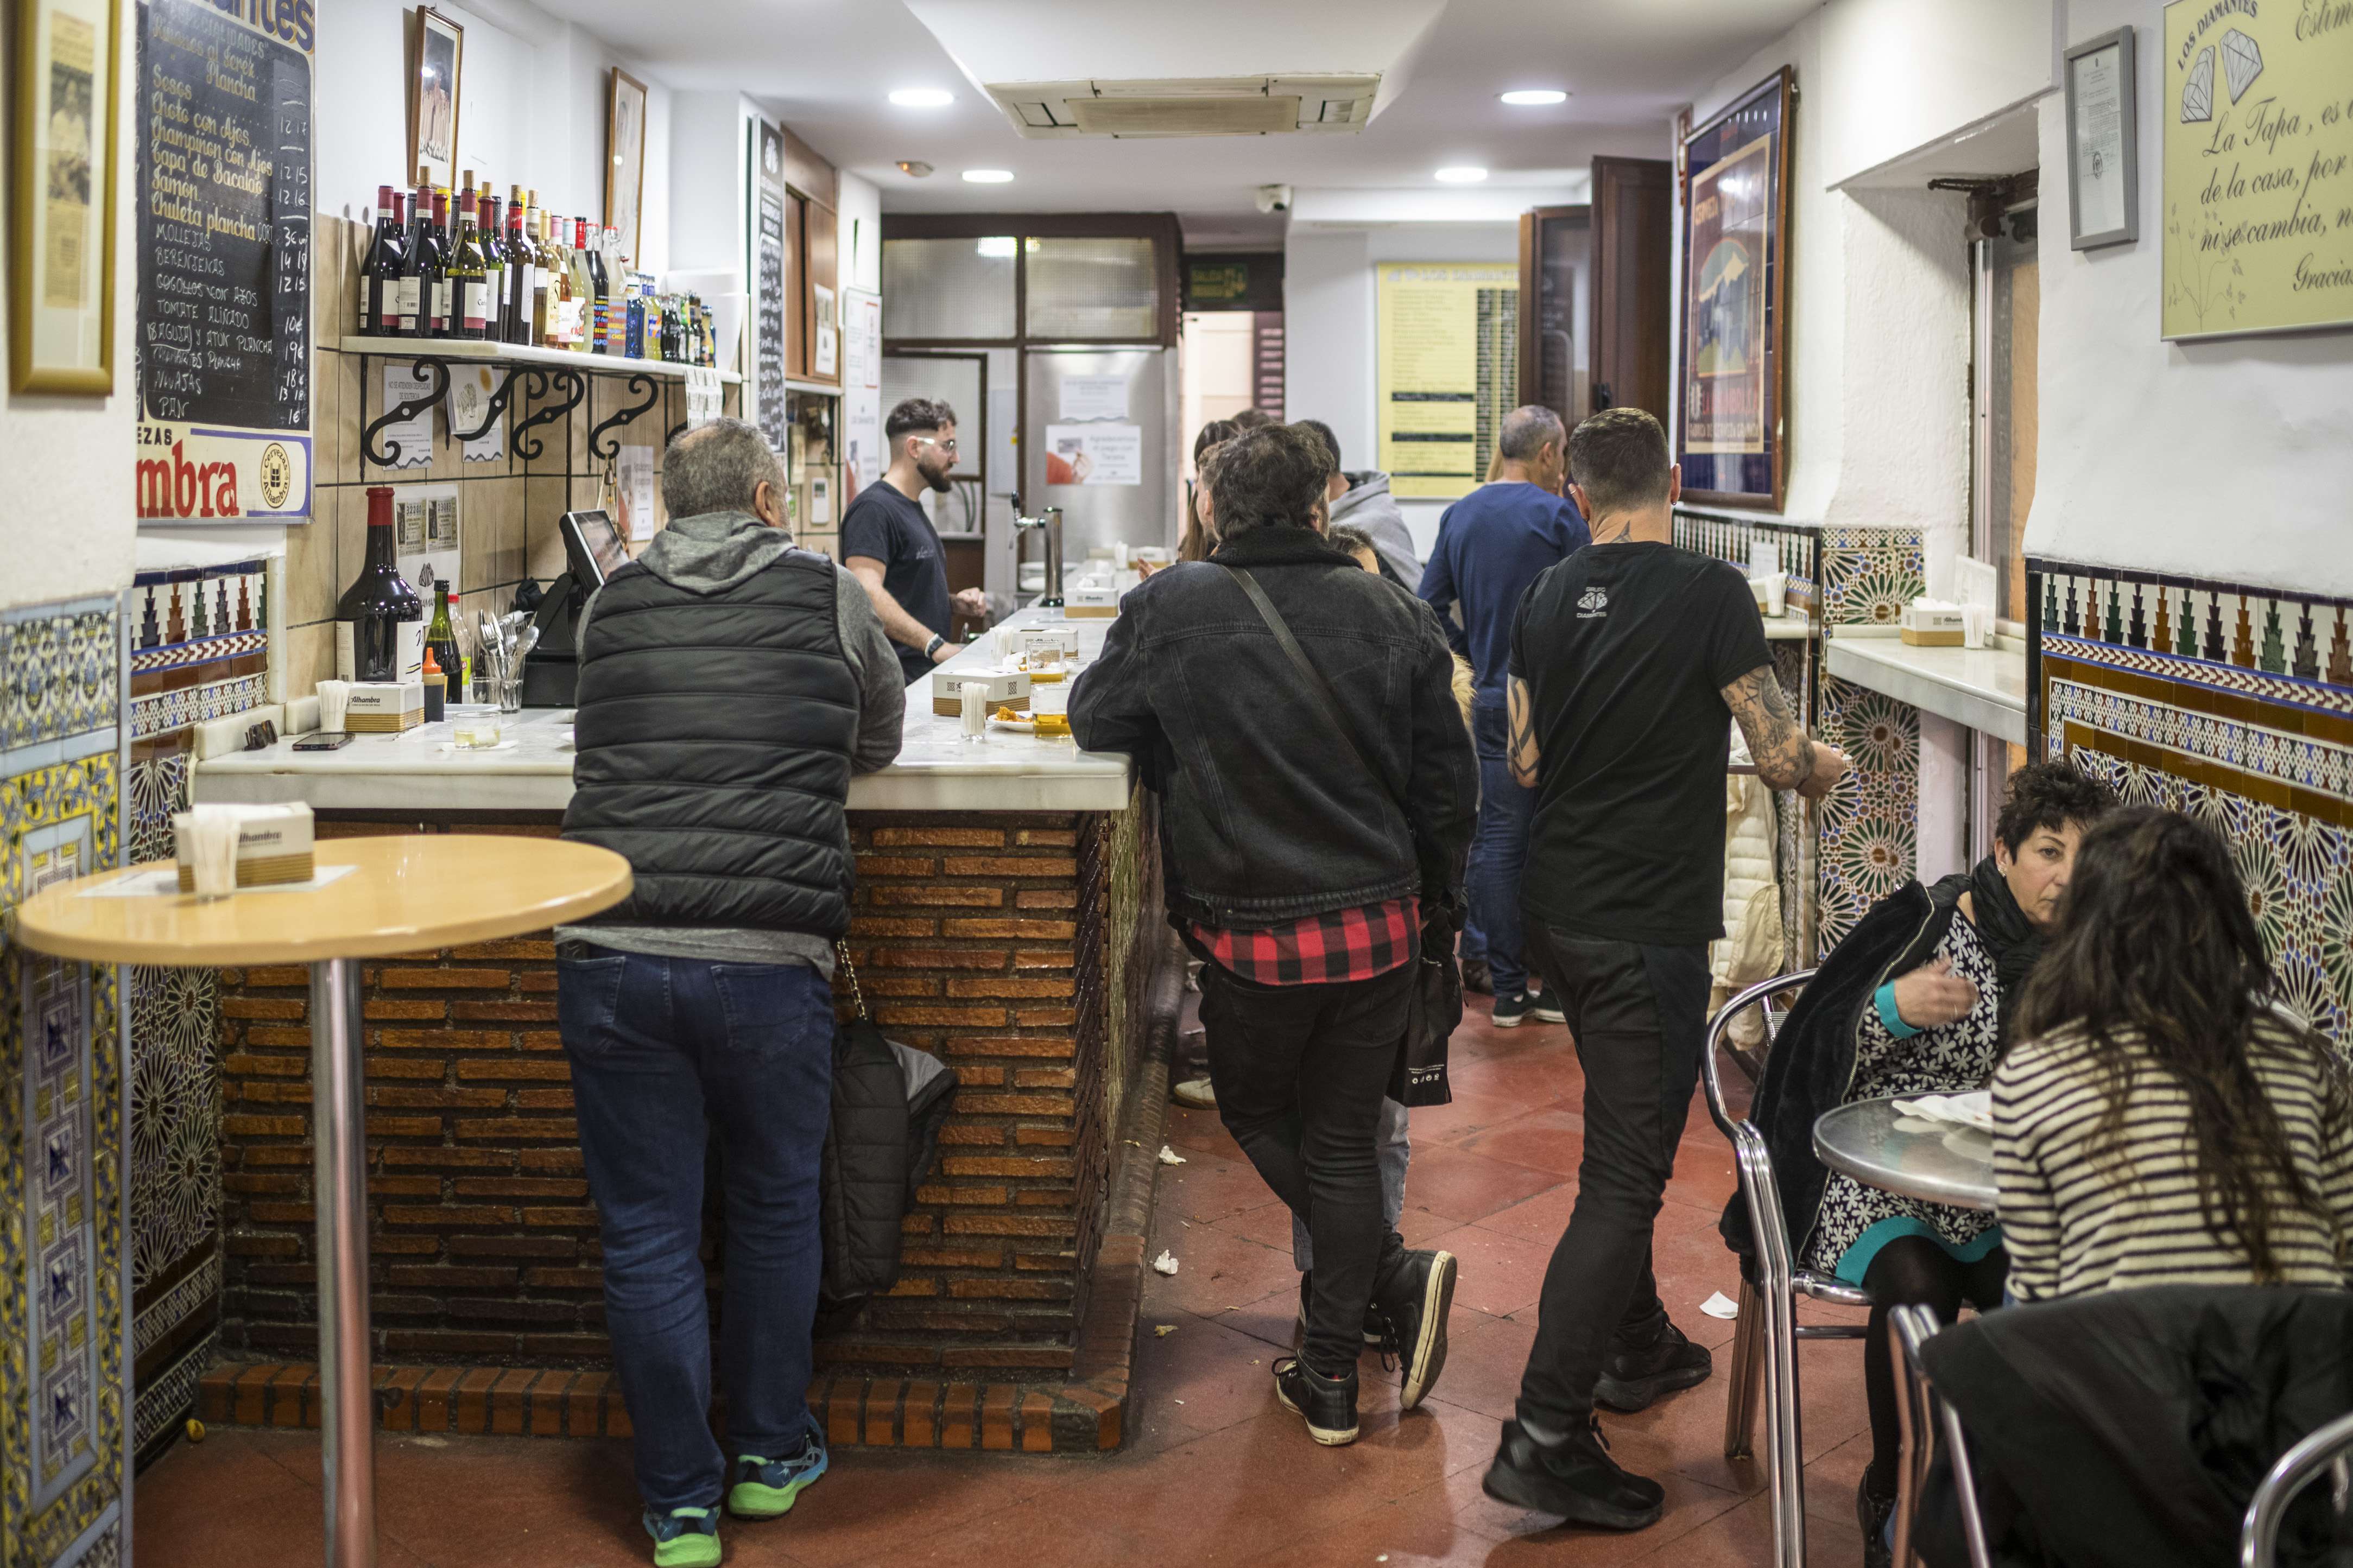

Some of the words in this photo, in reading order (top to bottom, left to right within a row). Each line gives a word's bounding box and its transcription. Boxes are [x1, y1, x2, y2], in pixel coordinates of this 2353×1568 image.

[2295, 0, 2353, 41] Estim
[2177, 31, 2196, 71] LOS
[2197, 0, 2257, 36] DIAMANTES
[154, 64, 192, 100] Sesos
[151, 91, 189, 124] Choto
[194, 113, 217, 135] con
[220, 116, 249, 148] Ajos
[281, 117, 292, 134] 12
[2202, 111, 2235, 157] La
[2322, 101, 2339, 125] es
[151, 139, 186, 175] Tapa
[193, 154, 208, 178] de
[213, 160, 263, 195] Bacalao
[225, 148, 244, 167] con
[248, 149, 273, 180] Ajos
[280, 163, 292, 180] 12
[296, 166, 307, 185] 15
[2201, 167, 2221, 205] de
[2227, 162, 2246, 199] la
[2252, 168, 2299, 194] casa,
[2301, 150, 2347, 199] por
[152, 164, 198, 201] Jamón
[279, 188, 290, 205] 12
[295, 189, 306, 207] 16
[151, 191, 203, 227] Chuleta
[206, 206, 256, 241] plancha
[2201, 221, 2222, 251] ni
[2224, 228, 2242, 247] se
[2247, 198, 2326, 237] cambia,
[156, 223, 212, 252] MOLLEJAS
[155, 246, 225, 276] BERENJENAS
[208, 286, 229, 301] CON
[233, 287, 257, 307] AJOS
[279, 276, 292, 294] 12
[157, 299, 199, 319] TOMATE
[236, 335, 273, 354] PLANCHA
[159, 397, 189, 418] PAN
[264, 449, 288, 471] Cervezas
[263, 481, 288, 505] Alhambra
[239, 830, 282, 843] lhambra
